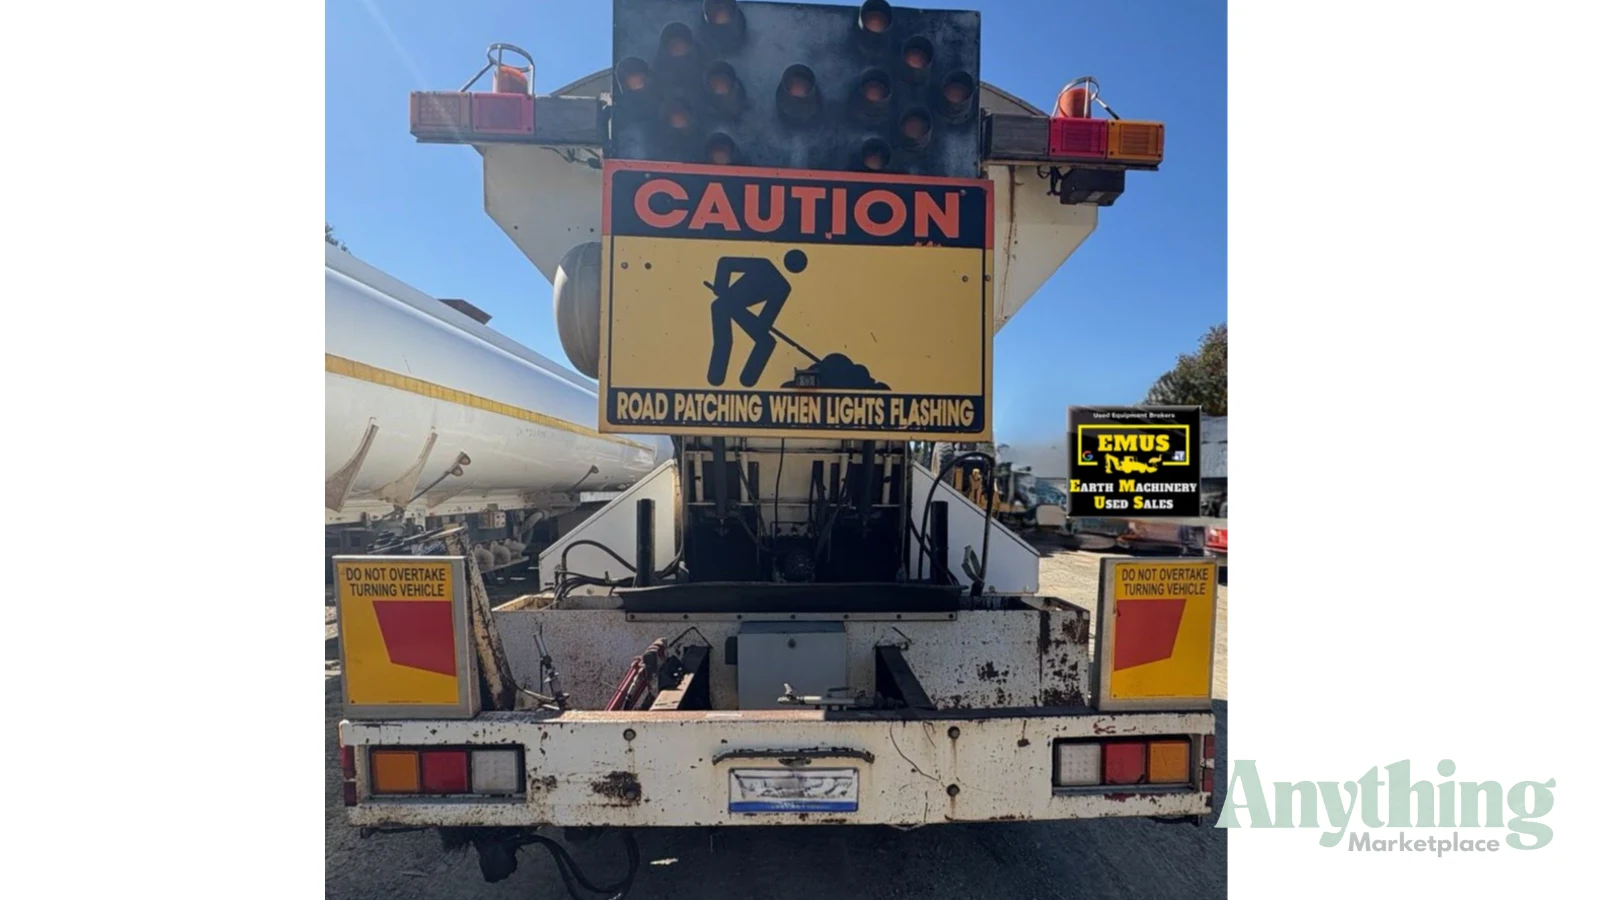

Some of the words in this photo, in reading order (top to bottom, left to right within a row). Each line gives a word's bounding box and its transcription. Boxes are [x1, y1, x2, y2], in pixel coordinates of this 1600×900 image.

[633, 177, 961, 239] CAUTION
[616, 391, 668, 421] ROAD
[674, 393, 763, 423] PATCHING
[769, 396, 821, 424] WHEN
[826, 398, 884, 426] LIGHTS
[890, 399, 975, 427] FLASHING
[345, 567, 362, 581] DO
[364, 567, 386, 581] NOT
[389, 568, 446, 581] OVERTAKE
[1121, 568, 1136, 581] DO
[1137, 568, 1157, 581] NOT
[1159, 568, 1209, 581] OVERTAKE
[349, 583, 397, 597] TURNING
[399, 583, 444, 597] VEHICLE
[1124, 583, 1165, 596] TURNING
[1166, 583, 1206, 596] VEHICLE
